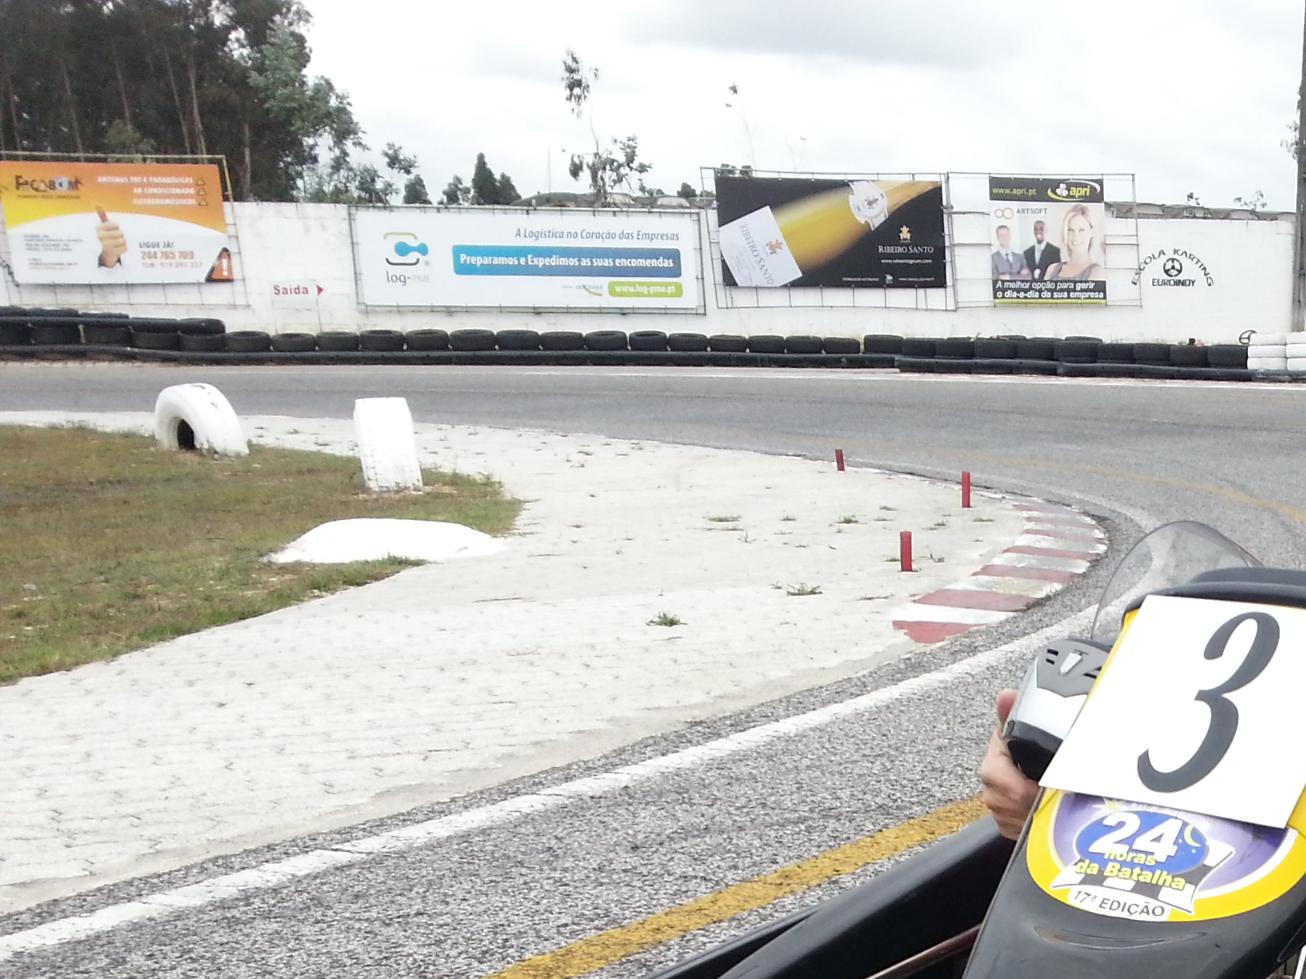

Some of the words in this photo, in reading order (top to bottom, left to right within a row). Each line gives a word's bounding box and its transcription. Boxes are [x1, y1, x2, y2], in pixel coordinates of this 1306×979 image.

[1069, 185, 1091, 199] apri
[1016, 207, 1048, 215] ARTSOFT
[515, 228, 522, 239] A
[566, 231, 578, 239] no
[580, 228, 616, 242] Coração
[618, 229, 635, 241] das
[636, 230, 680, 242] Empresas
[878, 244, 908, 254] RIBEIRO
[909, 245, 935, 254] SANTO
[460, 253, 519, 267] Preparamos
[519, 257, 526, 265] e
[527, 254, 580, 268] Expedimos
[580, 256, 592, 266] as
[592, 256, 614, 267] suas
[615, 256, 674, 268] encomendas
[1131, 249, 1166, 286] ESCOLA
[1173, 248, 1215, 287] KARTING
[995, 281, 1003, 289] A
[1004, 280, 1030, 289] melhor
[1031, 281, 1055, 291] opção
[1056, 282, 1074, 290] para
[1075, 281, 1096, 291] gerir
[1152, 279, 1196, 287] EUROINDY
[996, 290, 1003, 298] o
[1004, 290, 1040, 298] dia-a-dia
[1041, 290, 1052, 298] da
[1052, 290, 1068, 298] sua
[1069, 290, 1104, 300] empresa
[1137, 611, 1281, 794] 3
[1087, 811, 1184, 864] 24
[1103, 847, 1160, 867] horas
[1074, 858, 1100, 876] da
[1103, 861, 1187, 891] Batalha
[1099, 896, 1166, 918] EDIÇÃO
